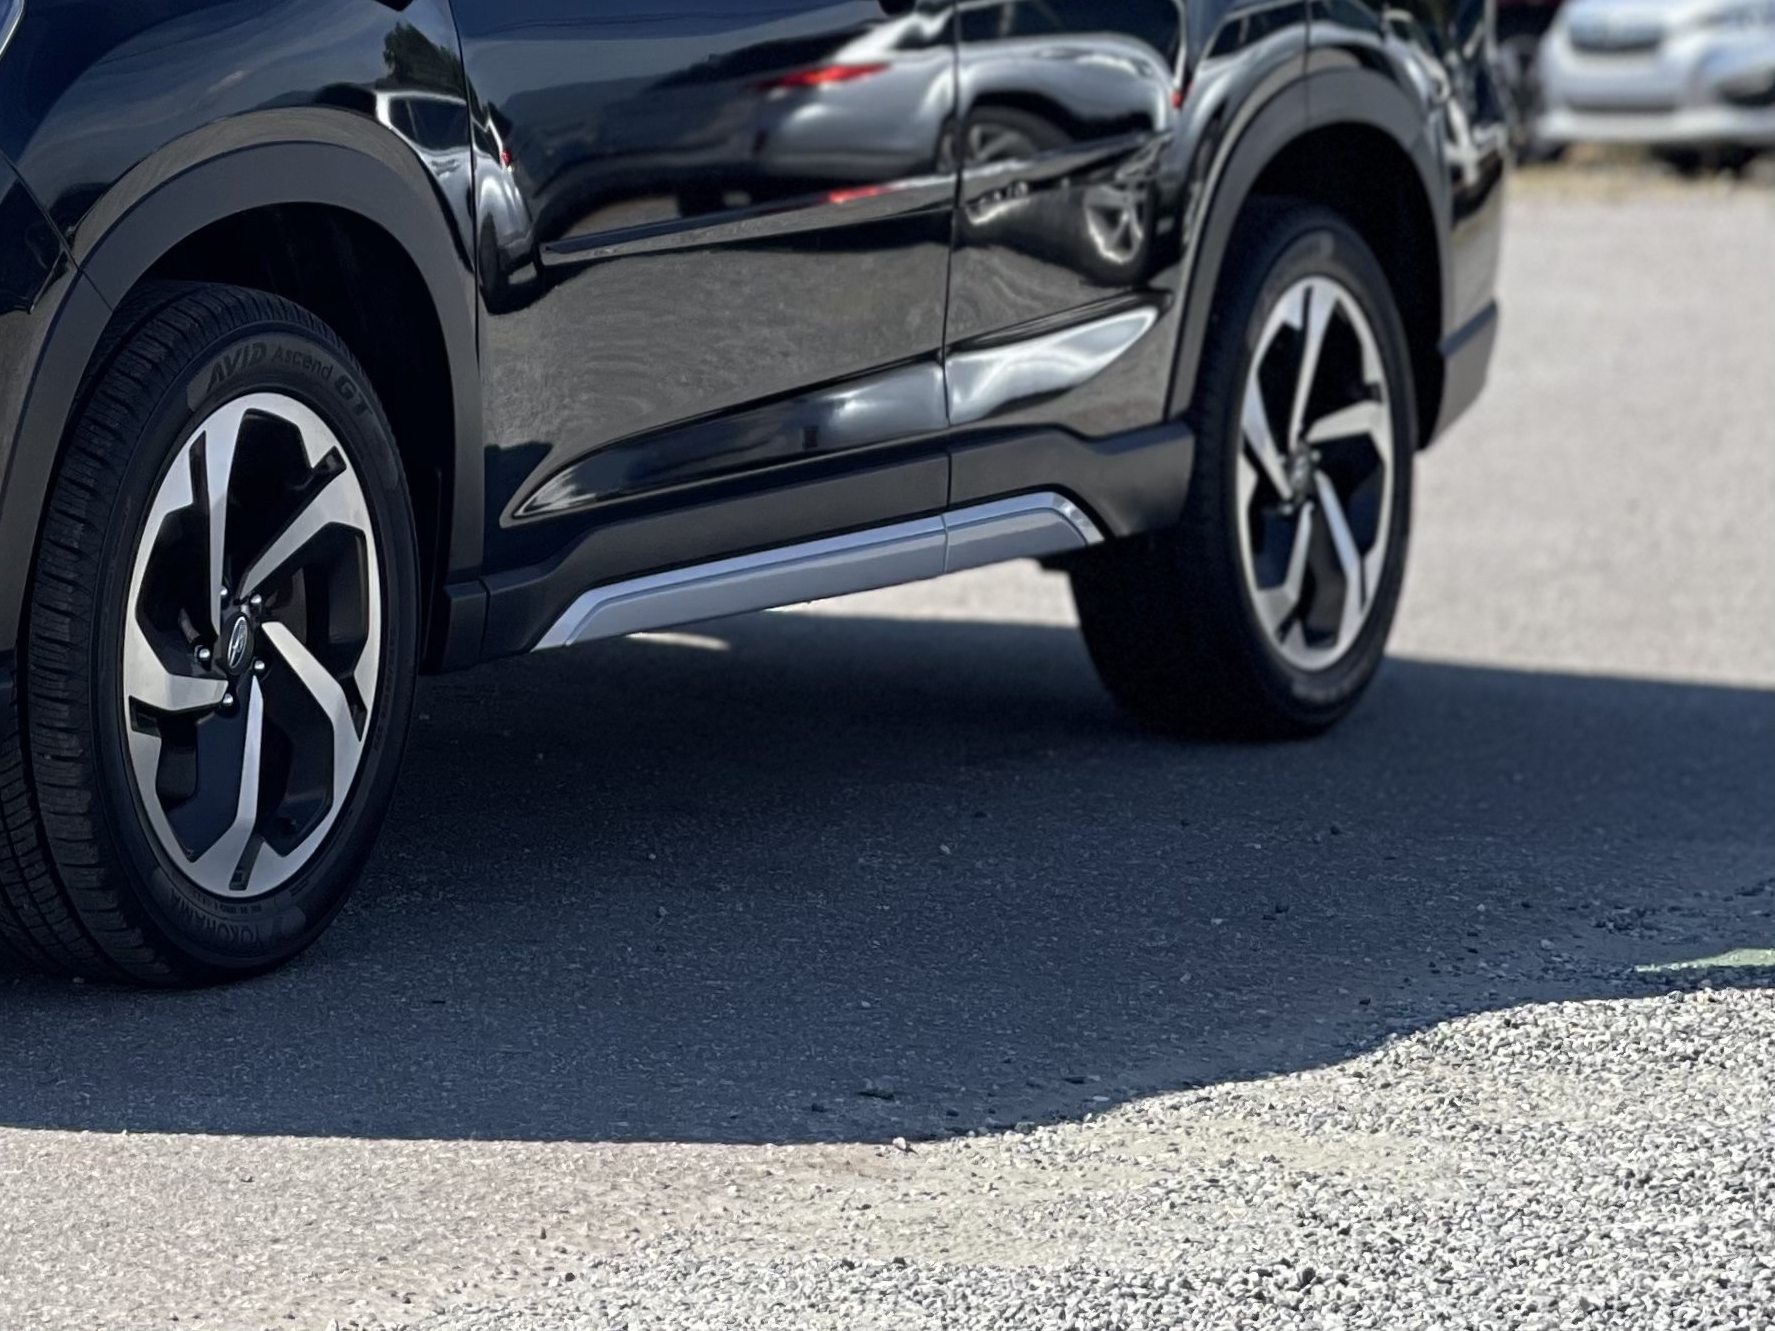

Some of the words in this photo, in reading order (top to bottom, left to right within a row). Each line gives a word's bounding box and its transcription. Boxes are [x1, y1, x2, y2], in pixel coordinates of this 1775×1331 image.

[207, 342, 267, 393] AVID
[271, 345, 333, 380] Ascend
[334, 375, 373, 416] GT
